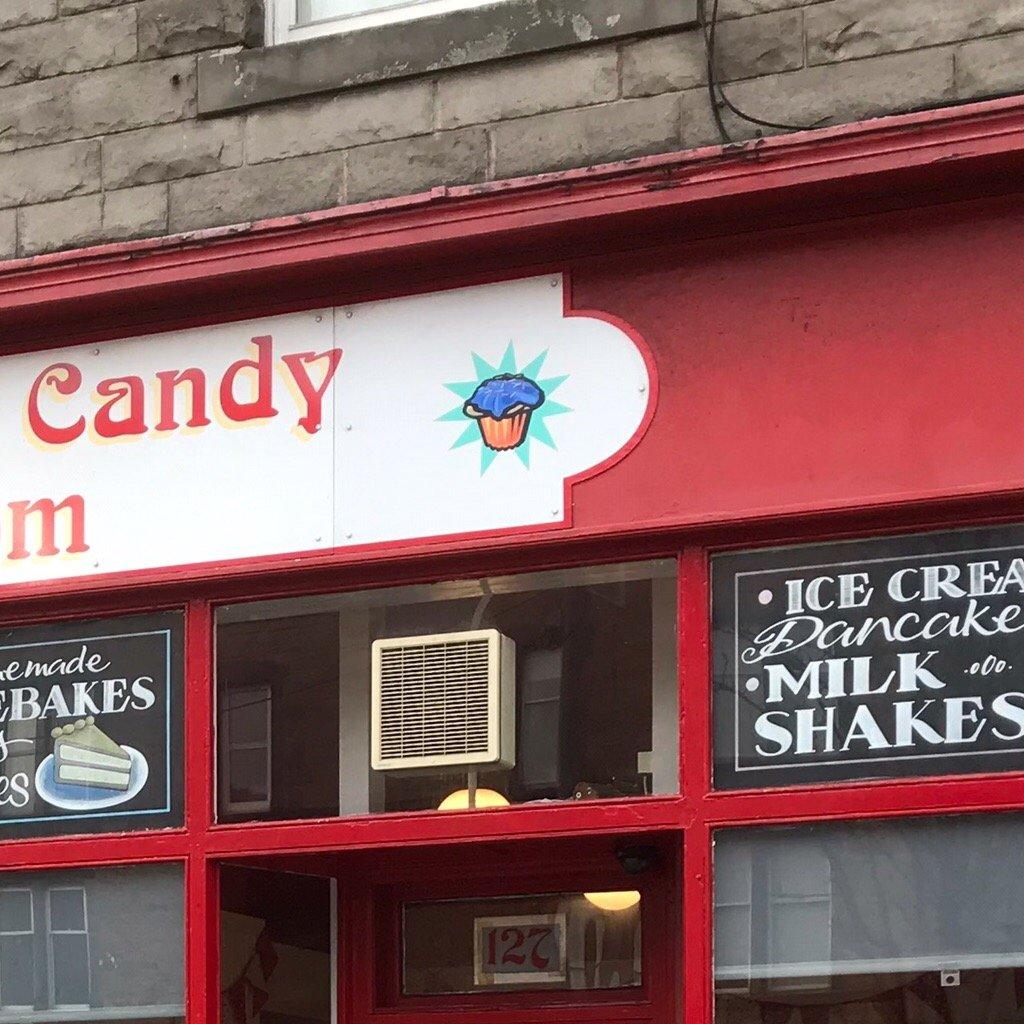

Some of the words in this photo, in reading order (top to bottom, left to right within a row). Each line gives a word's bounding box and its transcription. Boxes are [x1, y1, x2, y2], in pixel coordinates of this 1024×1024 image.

[27, 334, 343, 445] Candy
[785, 572, 874, 615] ICE
[887, 558, 1024, 602] CREA
[741, 599, 1024, 665] Pancake
[764, 650, 946, 703] MILK
[754, 692, 1024, 757] SHAKES
[487, 928, 552, 968] 127
